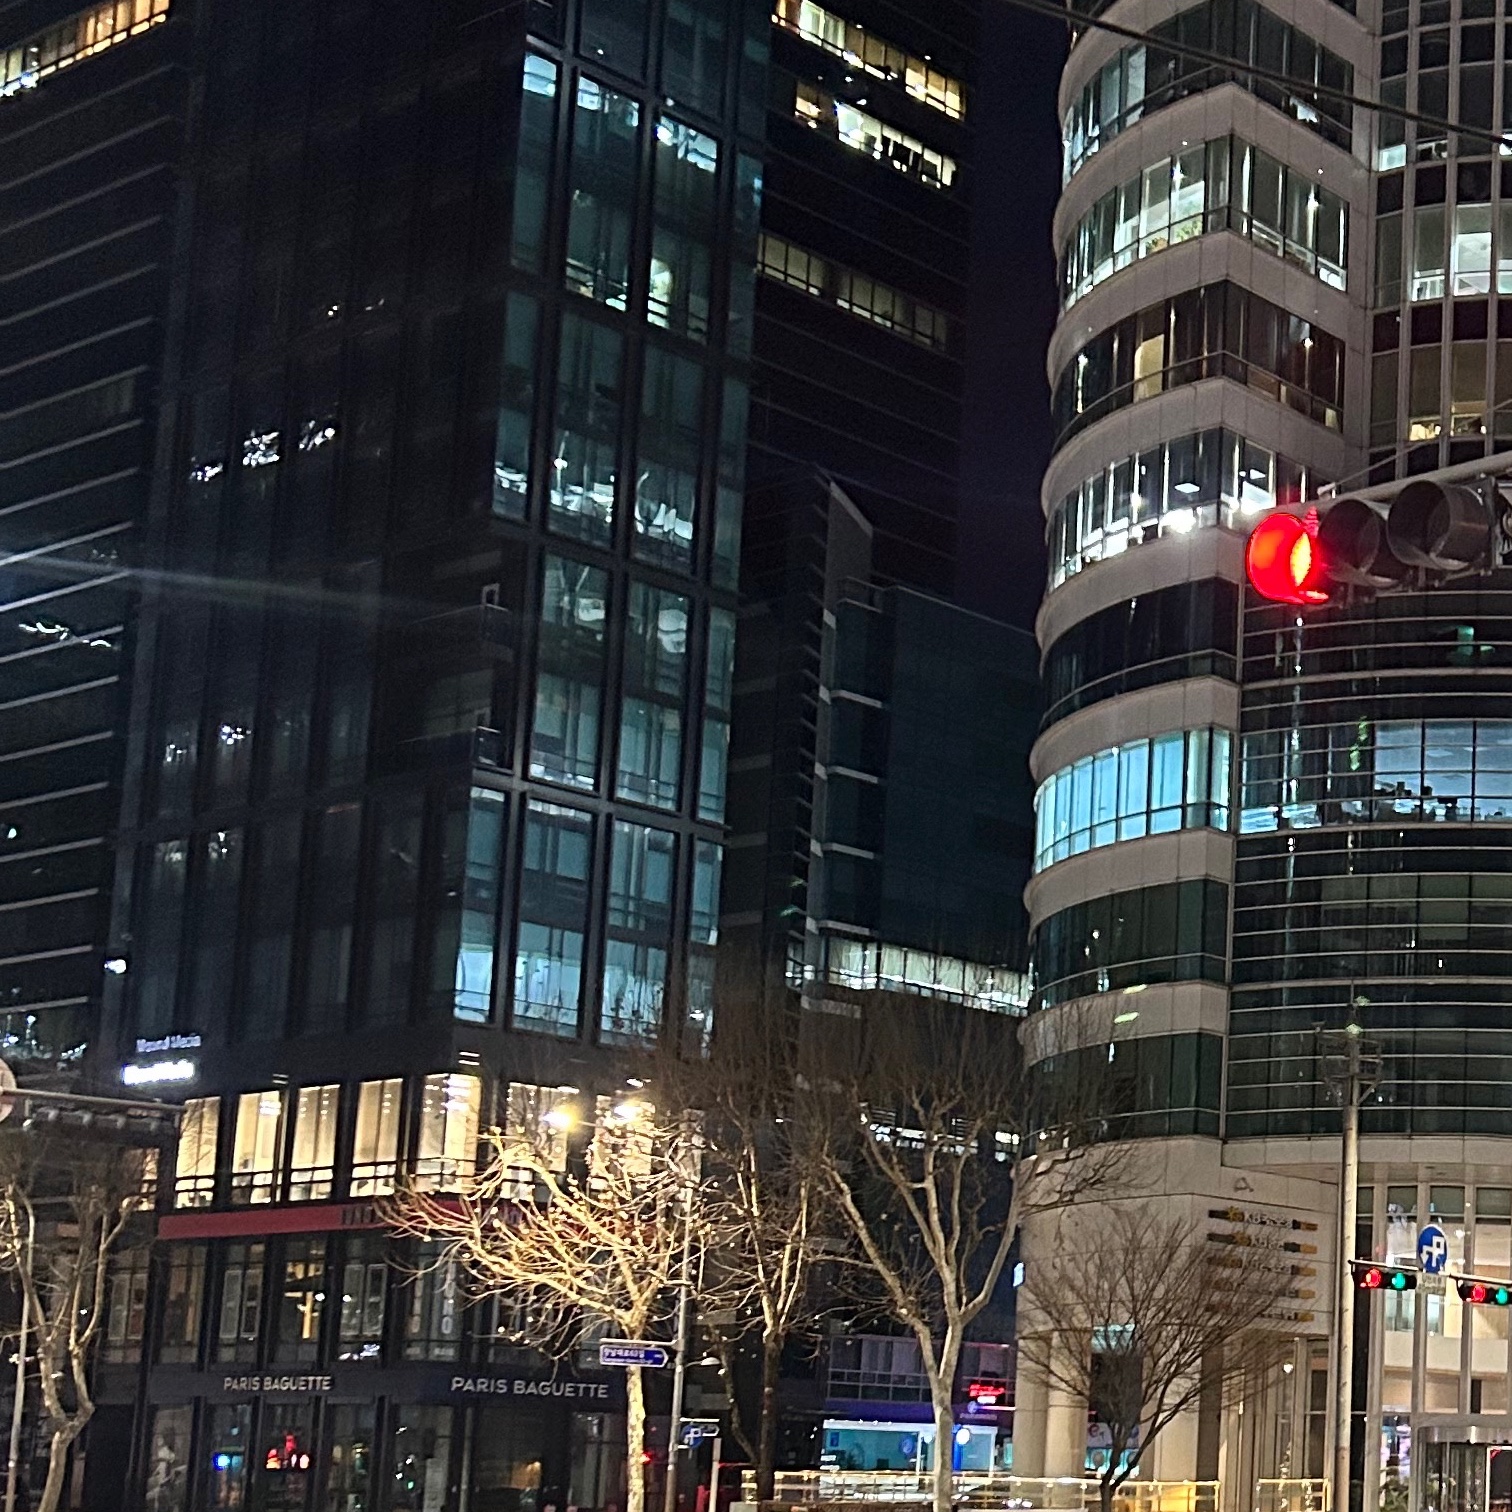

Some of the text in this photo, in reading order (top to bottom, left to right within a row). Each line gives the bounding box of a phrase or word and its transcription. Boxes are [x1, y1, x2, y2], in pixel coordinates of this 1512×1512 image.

[223, 1376, 332, 1391] PARIS BAGUETTE
[451, 1377, 609, 1399] PARIS BAGUETTE
